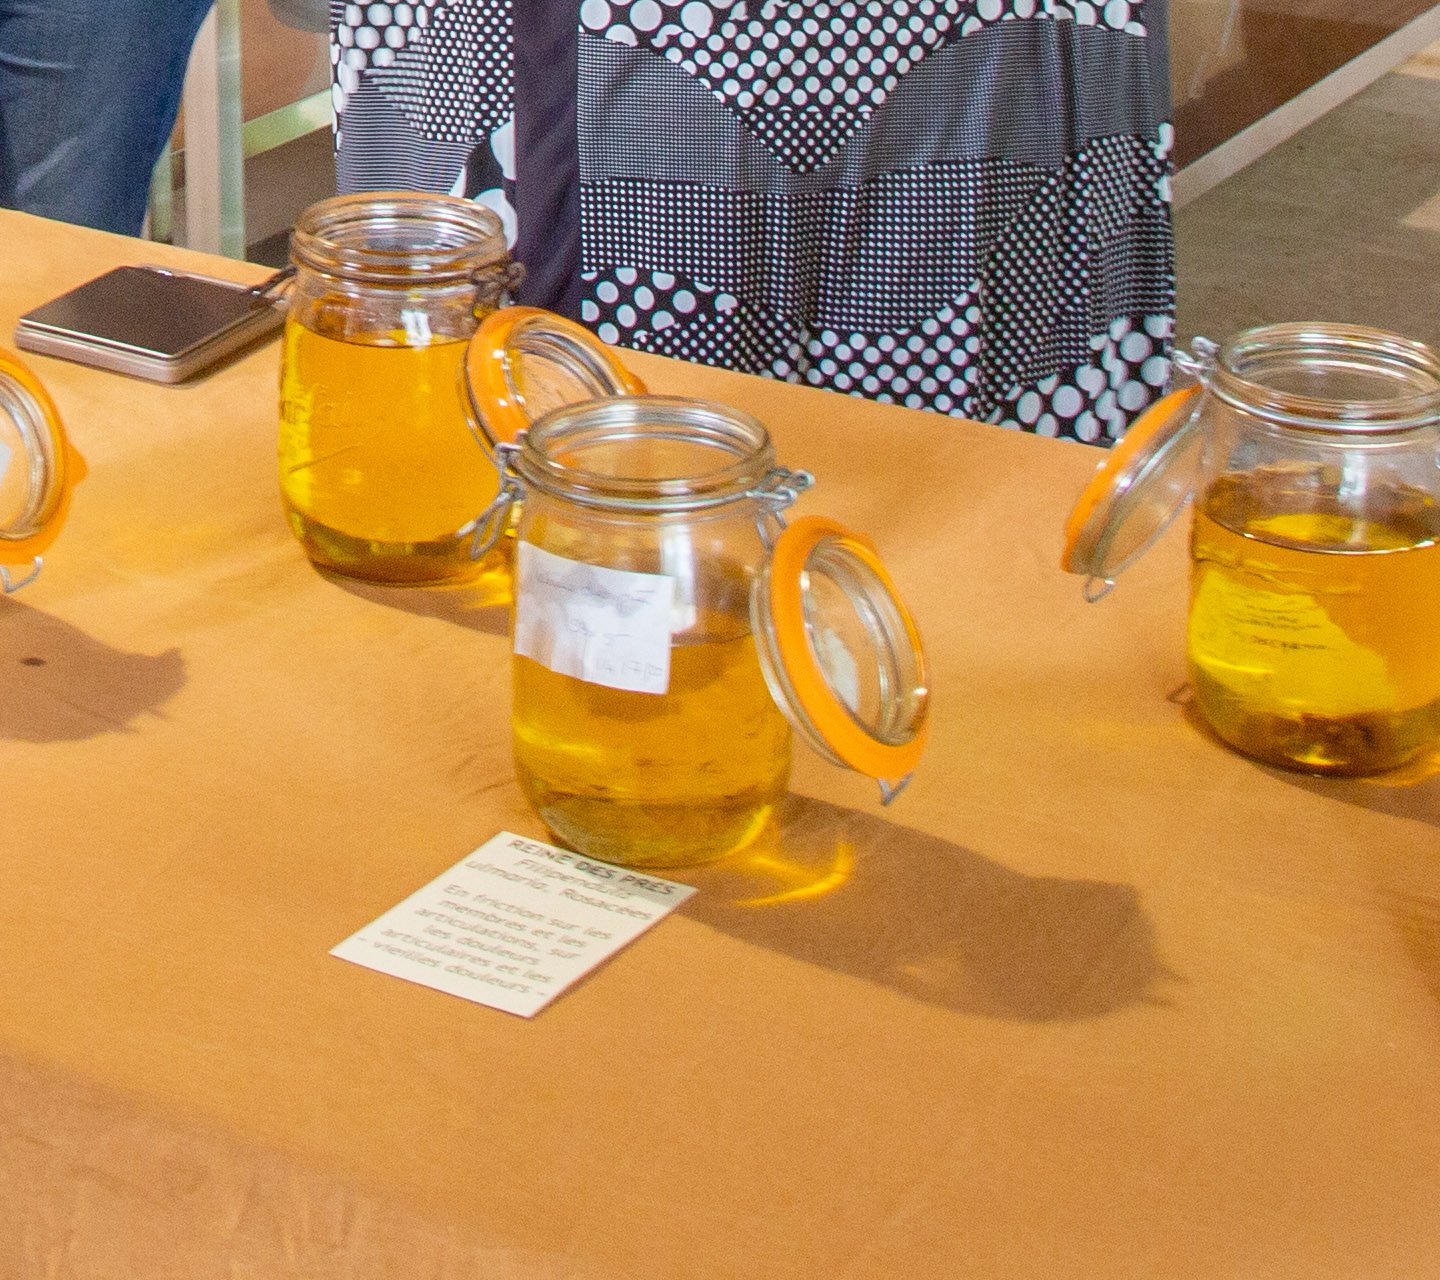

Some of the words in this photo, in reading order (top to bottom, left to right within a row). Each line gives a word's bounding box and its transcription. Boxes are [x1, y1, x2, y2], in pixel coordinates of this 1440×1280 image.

[505, 839, 575, 864] REINE
[572, 860, 619, 878] DES
[436, 899, 530, 931] membres
[529, 928, 555, 938] et
[556, 935, 589, 948] les
[441, 884, 473, 897] En
[471, 893, 549, 920] friction
[546, 918, 579, 931] sur
[582, 927, 615, 940] les
[369, 940, 444, 967] vieilles
[443, 963, 531, 994] douleurs
[379, 927, 495, 966] articulaires
[493, 963, 520, 974] et
[521, 970, 552, 983] les
[422, 925, 455, 938] les
[454, 935, 542, 965] douleurs
[546, 947, 581, 960] sur
